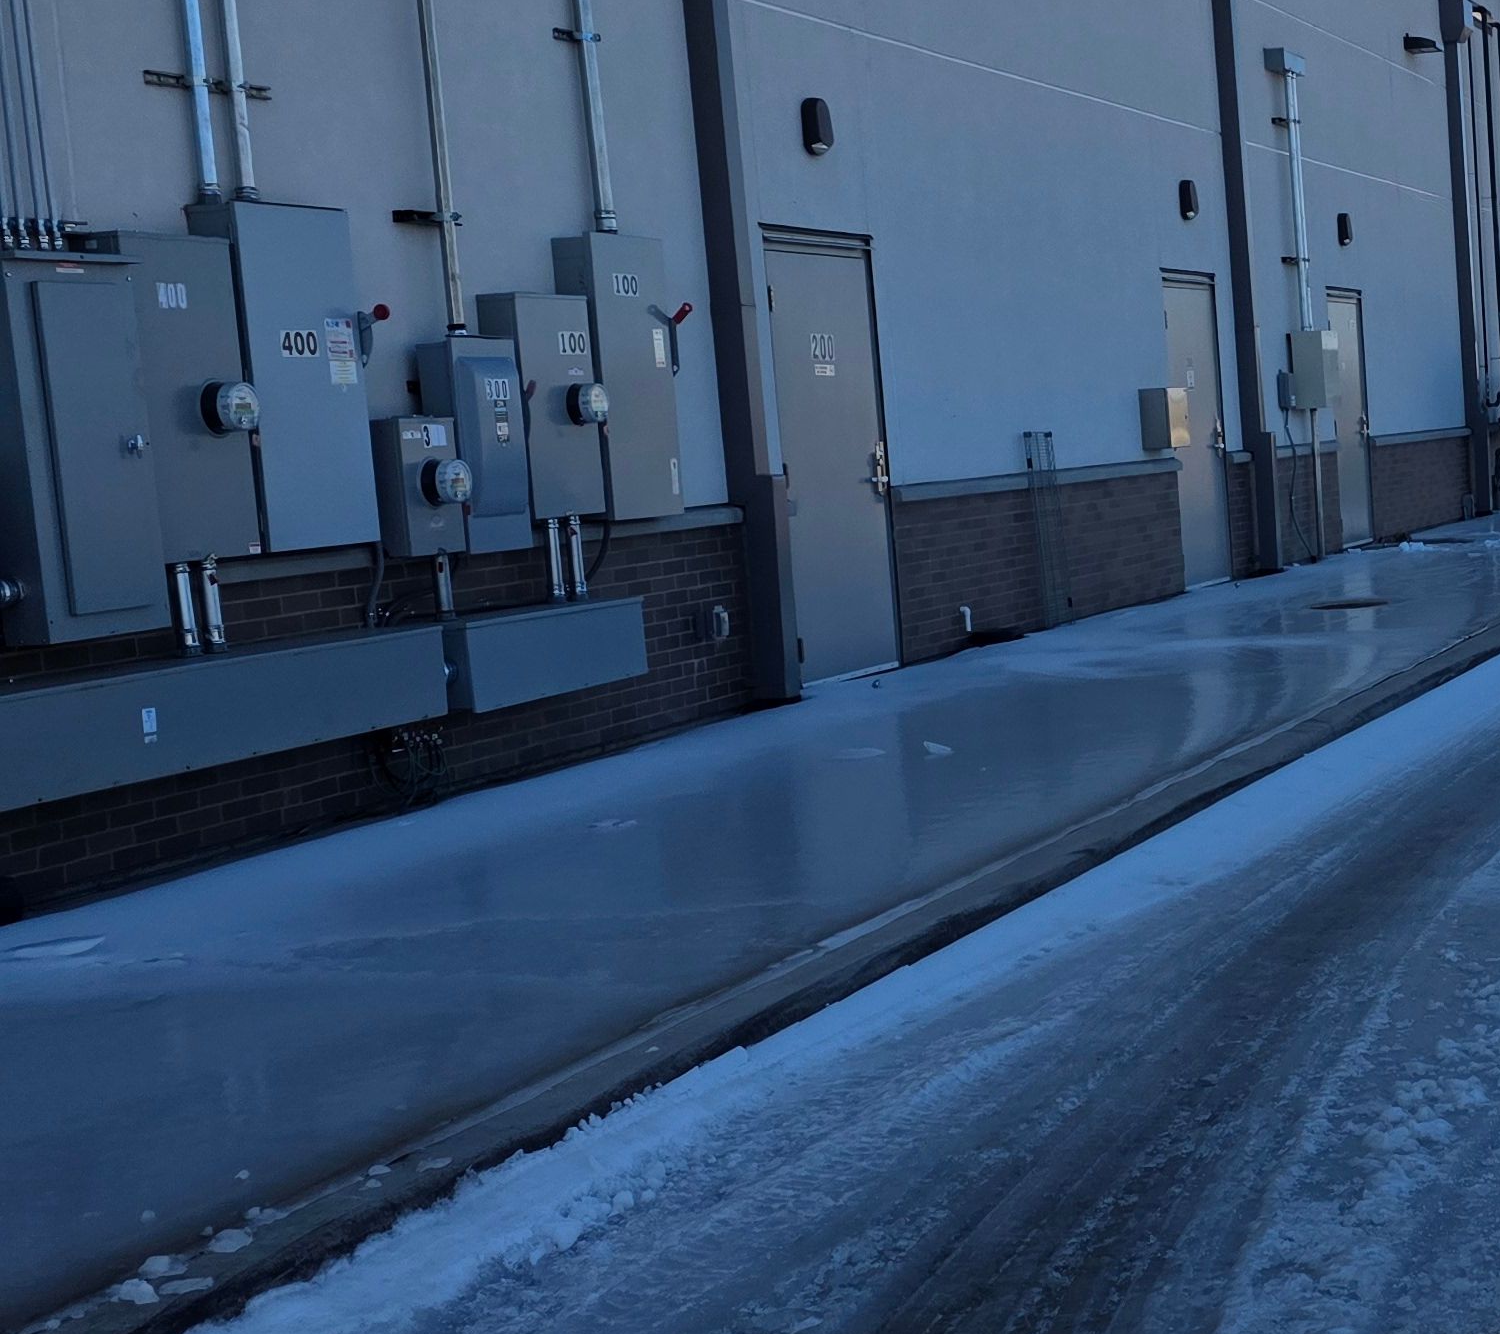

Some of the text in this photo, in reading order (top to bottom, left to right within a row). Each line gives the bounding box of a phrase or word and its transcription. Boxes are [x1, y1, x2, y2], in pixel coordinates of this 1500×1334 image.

[614, 274, 638, 295] 100
[282, 331, 318, 356] 400
[560, 332, 586, 354] 100
[811, 334, 834, 360] 200
[486, 380, 509, 399] 300
